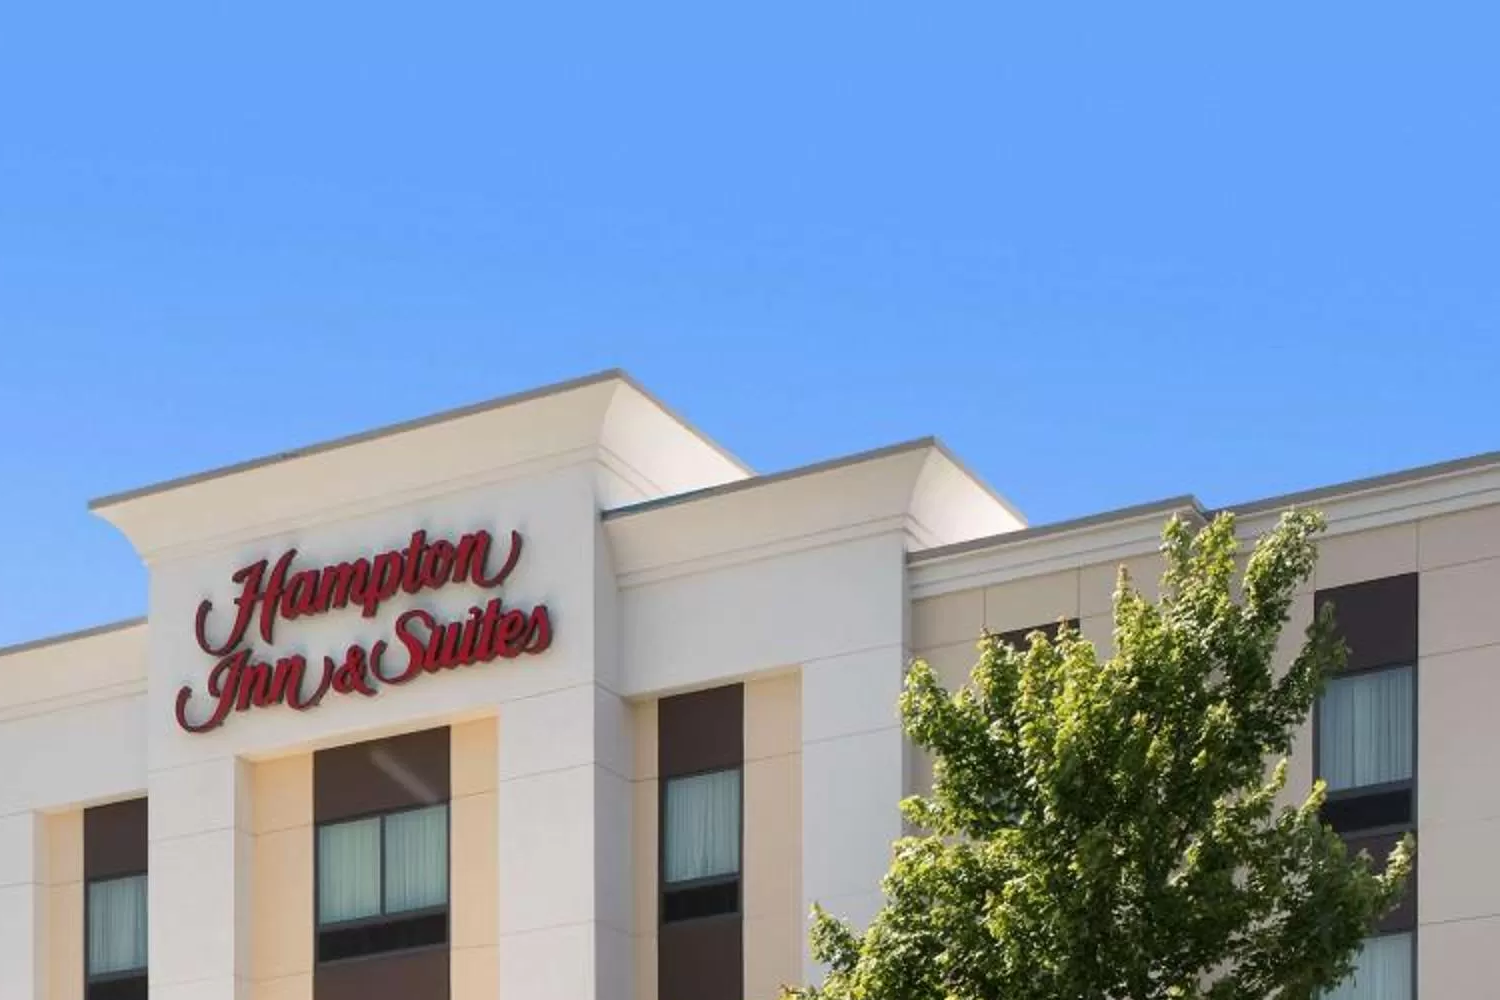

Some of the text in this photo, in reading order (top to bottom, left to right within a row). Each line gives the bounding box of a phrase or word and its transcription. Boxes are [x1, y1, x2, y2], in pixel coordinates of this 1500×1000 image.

[196, 529, 522, 656] Hampton
[175, 597, 553, 733] Inn & Suites
